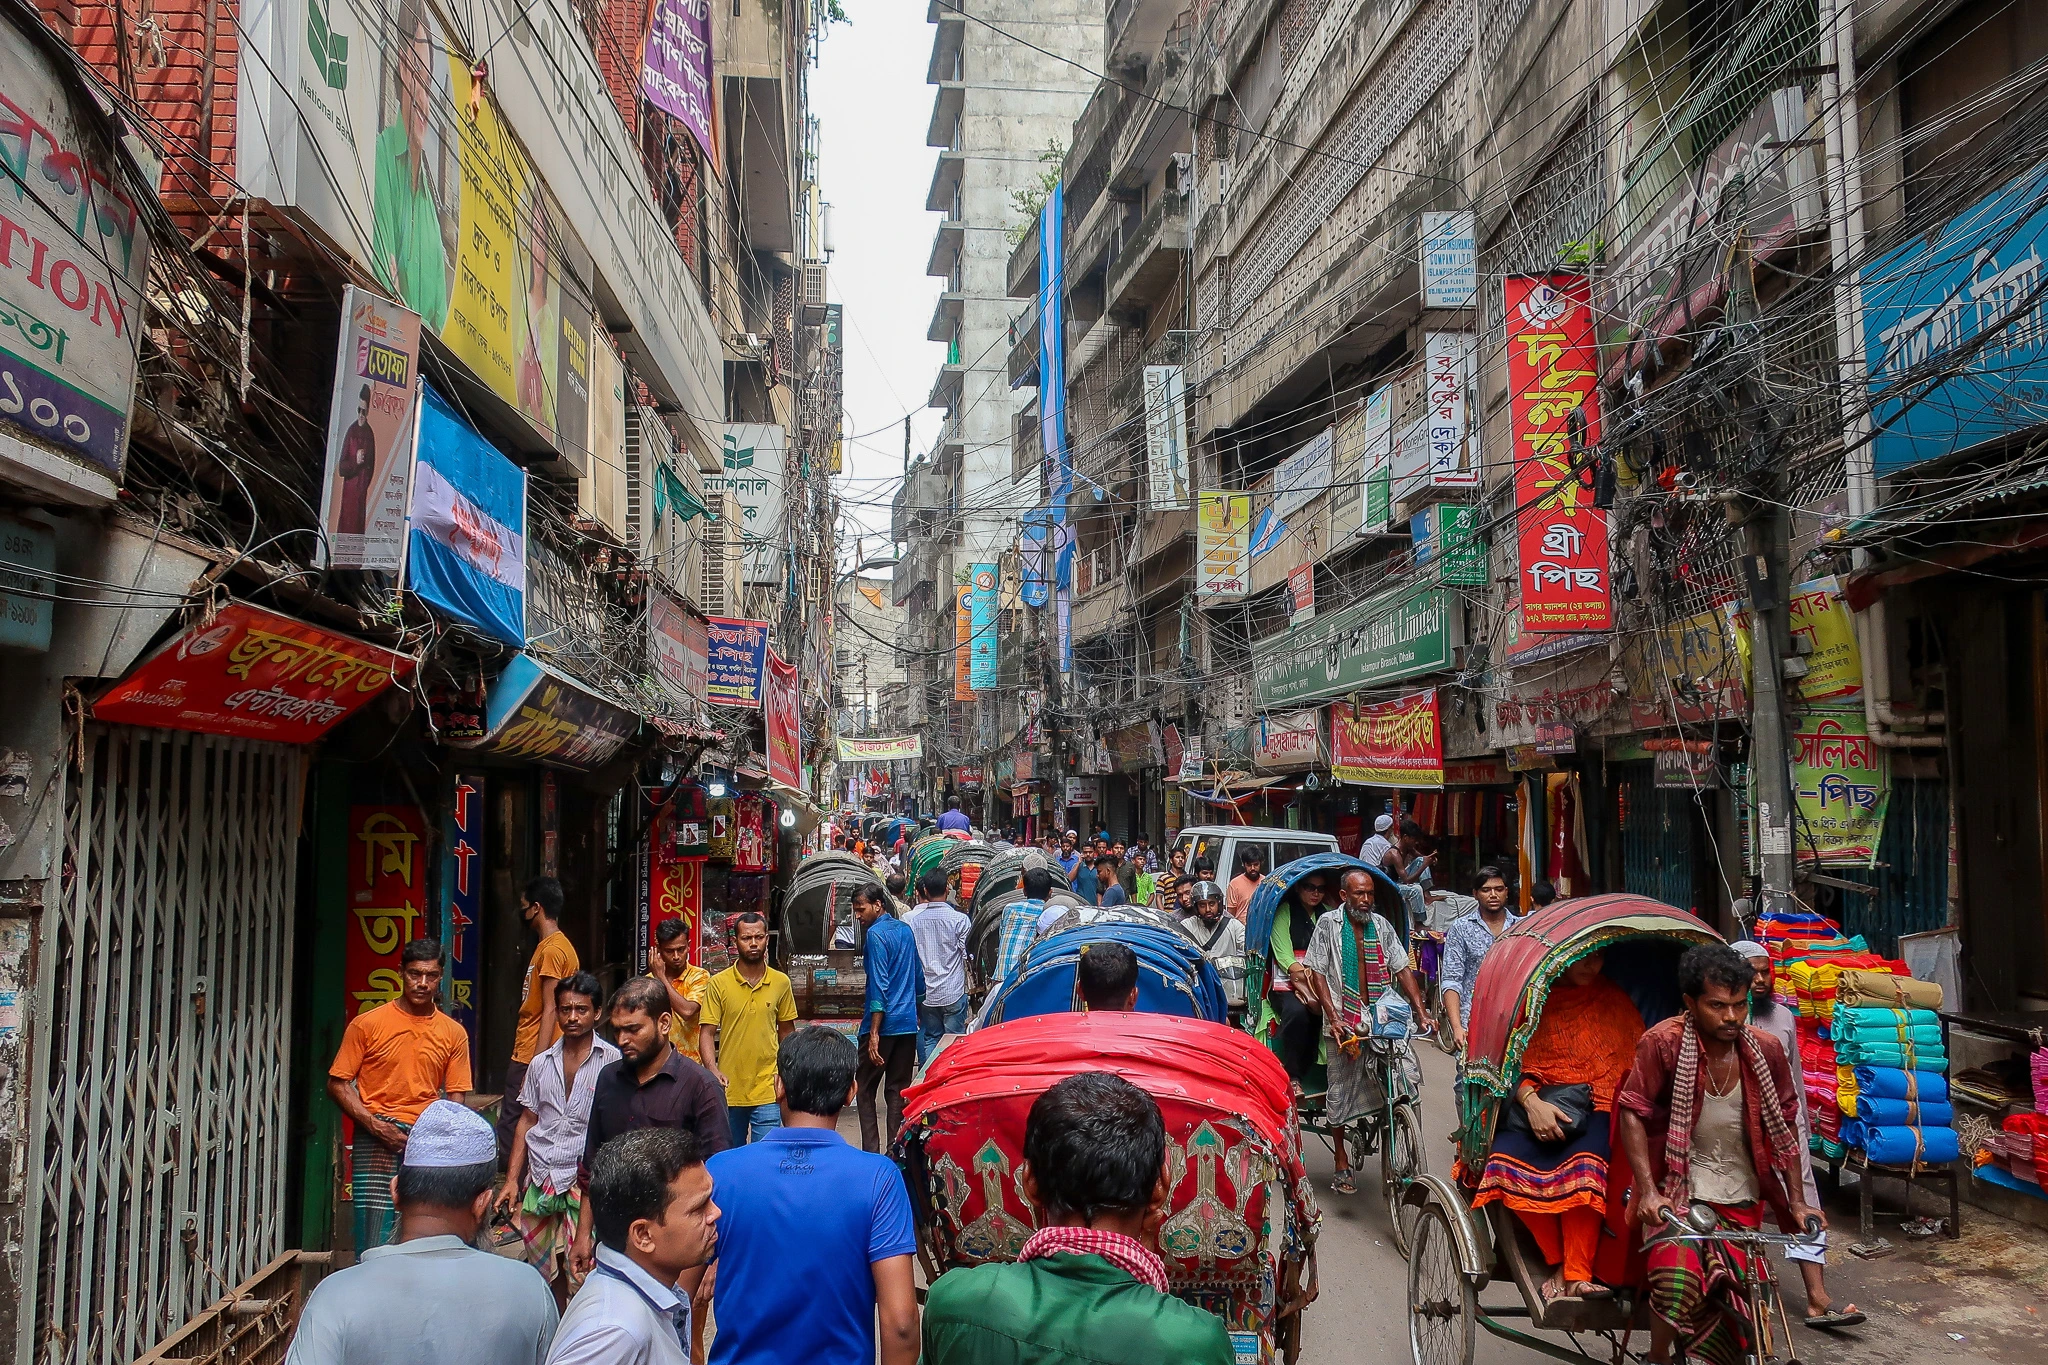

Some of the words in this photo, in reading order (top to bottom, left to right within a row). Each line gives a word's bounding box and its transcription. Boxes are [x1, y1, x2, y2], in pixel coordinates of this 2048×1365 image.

[300, 76, 334, 124] National
[1430, 253, 1456, 265] COMPANY
[1446, 238, 1475, 251] INSURANCE
[0, 214, 128, 339] TION
[1427, 267, 1453, 277] ISLAMPUR
[369, 345, 409, 385] তোফা
[1430, 356, 1461, 421] বন্দুকের
[1431, 425, 1458, 471] দোকান
[703, 477, 769, 496] ন্যাশনাল
[1526, 562, 1604, 595] পিছ
[1525, 602, 1542, 611] সাগর
[1543, 602, 1568, 611] ম্যানশন
[1542, 611, 1565, 623] ইসলামপুর
[1790, 590, 1831, 619] বার
[708, 623, 764, 648] কিস্তানী
[1371, 613, 1397, 651] Bank
[1398, 595, 1440, 644] Limited
[227, 628, 400, 693] জুনায়েত
[708, 646, 755, 665] -পিছ
[1360, 660, 1381, 674] Islampur
[1380, 655, 1399, 669] Branch,
[1398, 650, 1415, 664] Dhaka
[224, 683, 348, 726] এন্টারপ্রাইজ
[1373, 701, 1435, 755] এন্টারপ্রাইজ
[853, 740, 893, 753] ডিজিটাল
[896, 738, 918, 753] শাড়ী
[1793, 719, 1878, 772] সলিমা
[1795, 773, 1878, 813] -পিছ
[639, 879, 648, 899] রোড,
[779, 1160, 815, 1175] Fancy
